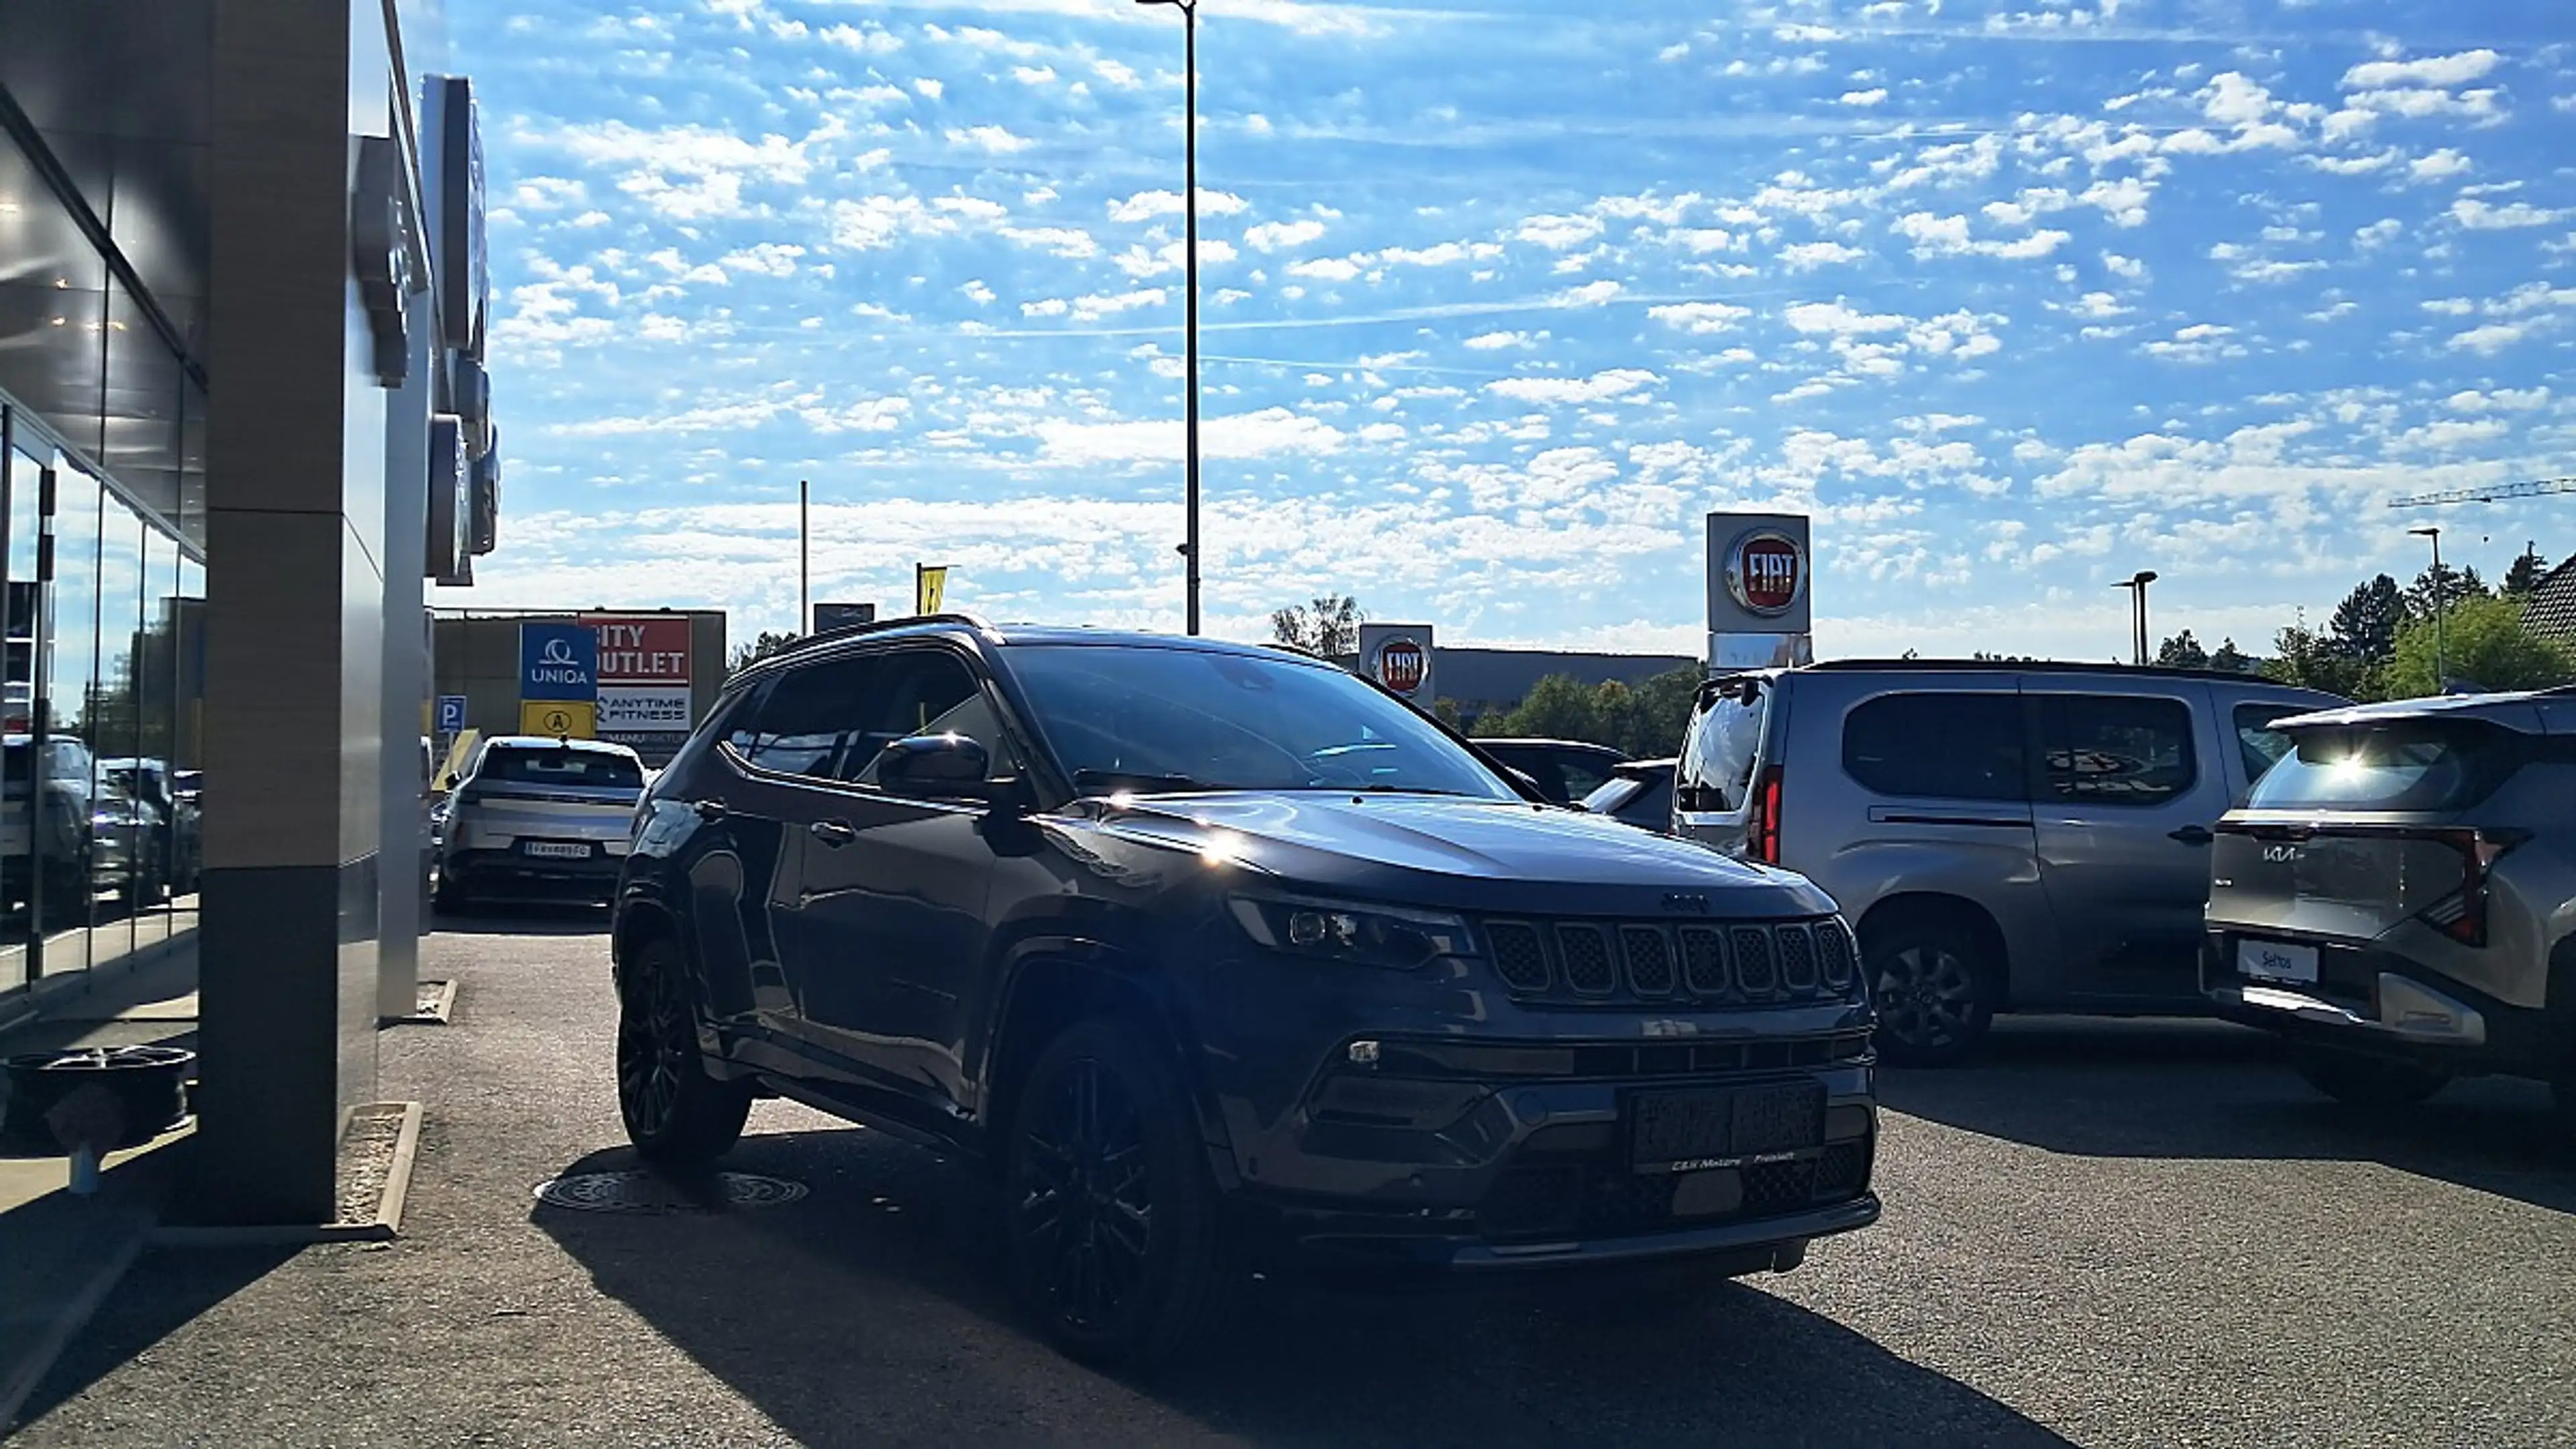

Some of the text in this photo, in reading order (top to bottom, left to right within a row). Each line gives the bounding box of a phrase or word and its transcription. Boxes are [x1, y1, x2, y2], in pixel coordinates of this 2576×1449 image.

[1750, 553, 1794, 593] FIAT
[596, 625, 645, 647] ITY
[596, 651, 684, 673] UTLET
[1387, 652, 1419, 682] FIAT
[531, 668, 588, 684] UNIQA
[609, 698, 685, 708] ANYTIME
[443, 704, 458, 726] P
[609, 710, 686, 720] FITNESS
[2263, 951, 2292, 969] Seltos
